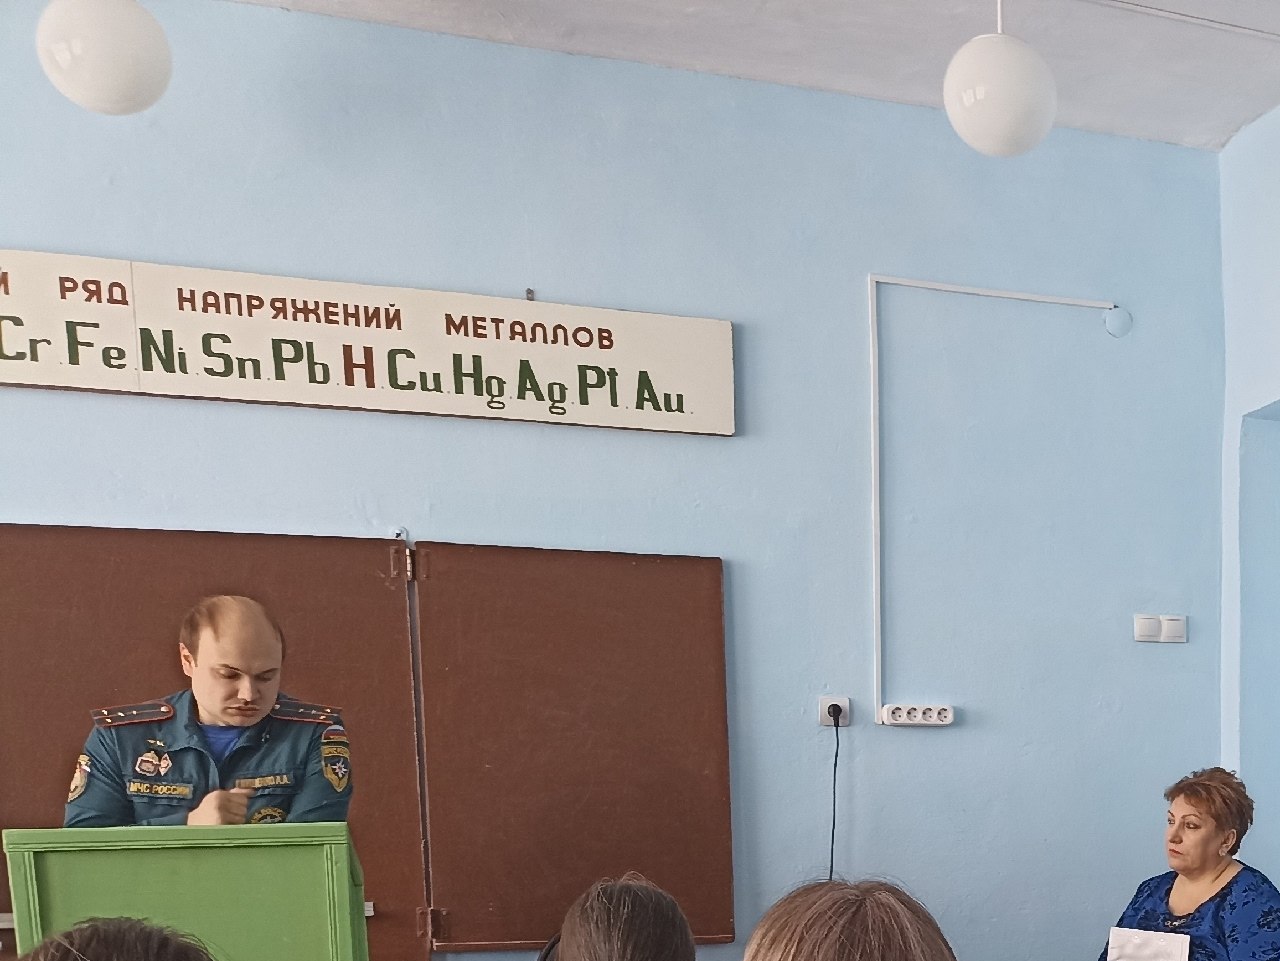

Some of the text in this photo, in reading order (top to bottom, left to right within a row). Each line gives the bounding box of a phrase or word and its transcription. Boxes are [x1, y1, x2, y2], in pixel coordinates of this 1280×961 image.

[58, 276, 614, 350] РЯД НАПРЯЖЕНИЙ МЕТАЛЛОВ
[0, 315, 685, 415] Cr Fe Ni Sn Pb H Cu Hg Ag Pt Au
[130, 782, 150, 793] МЧС
